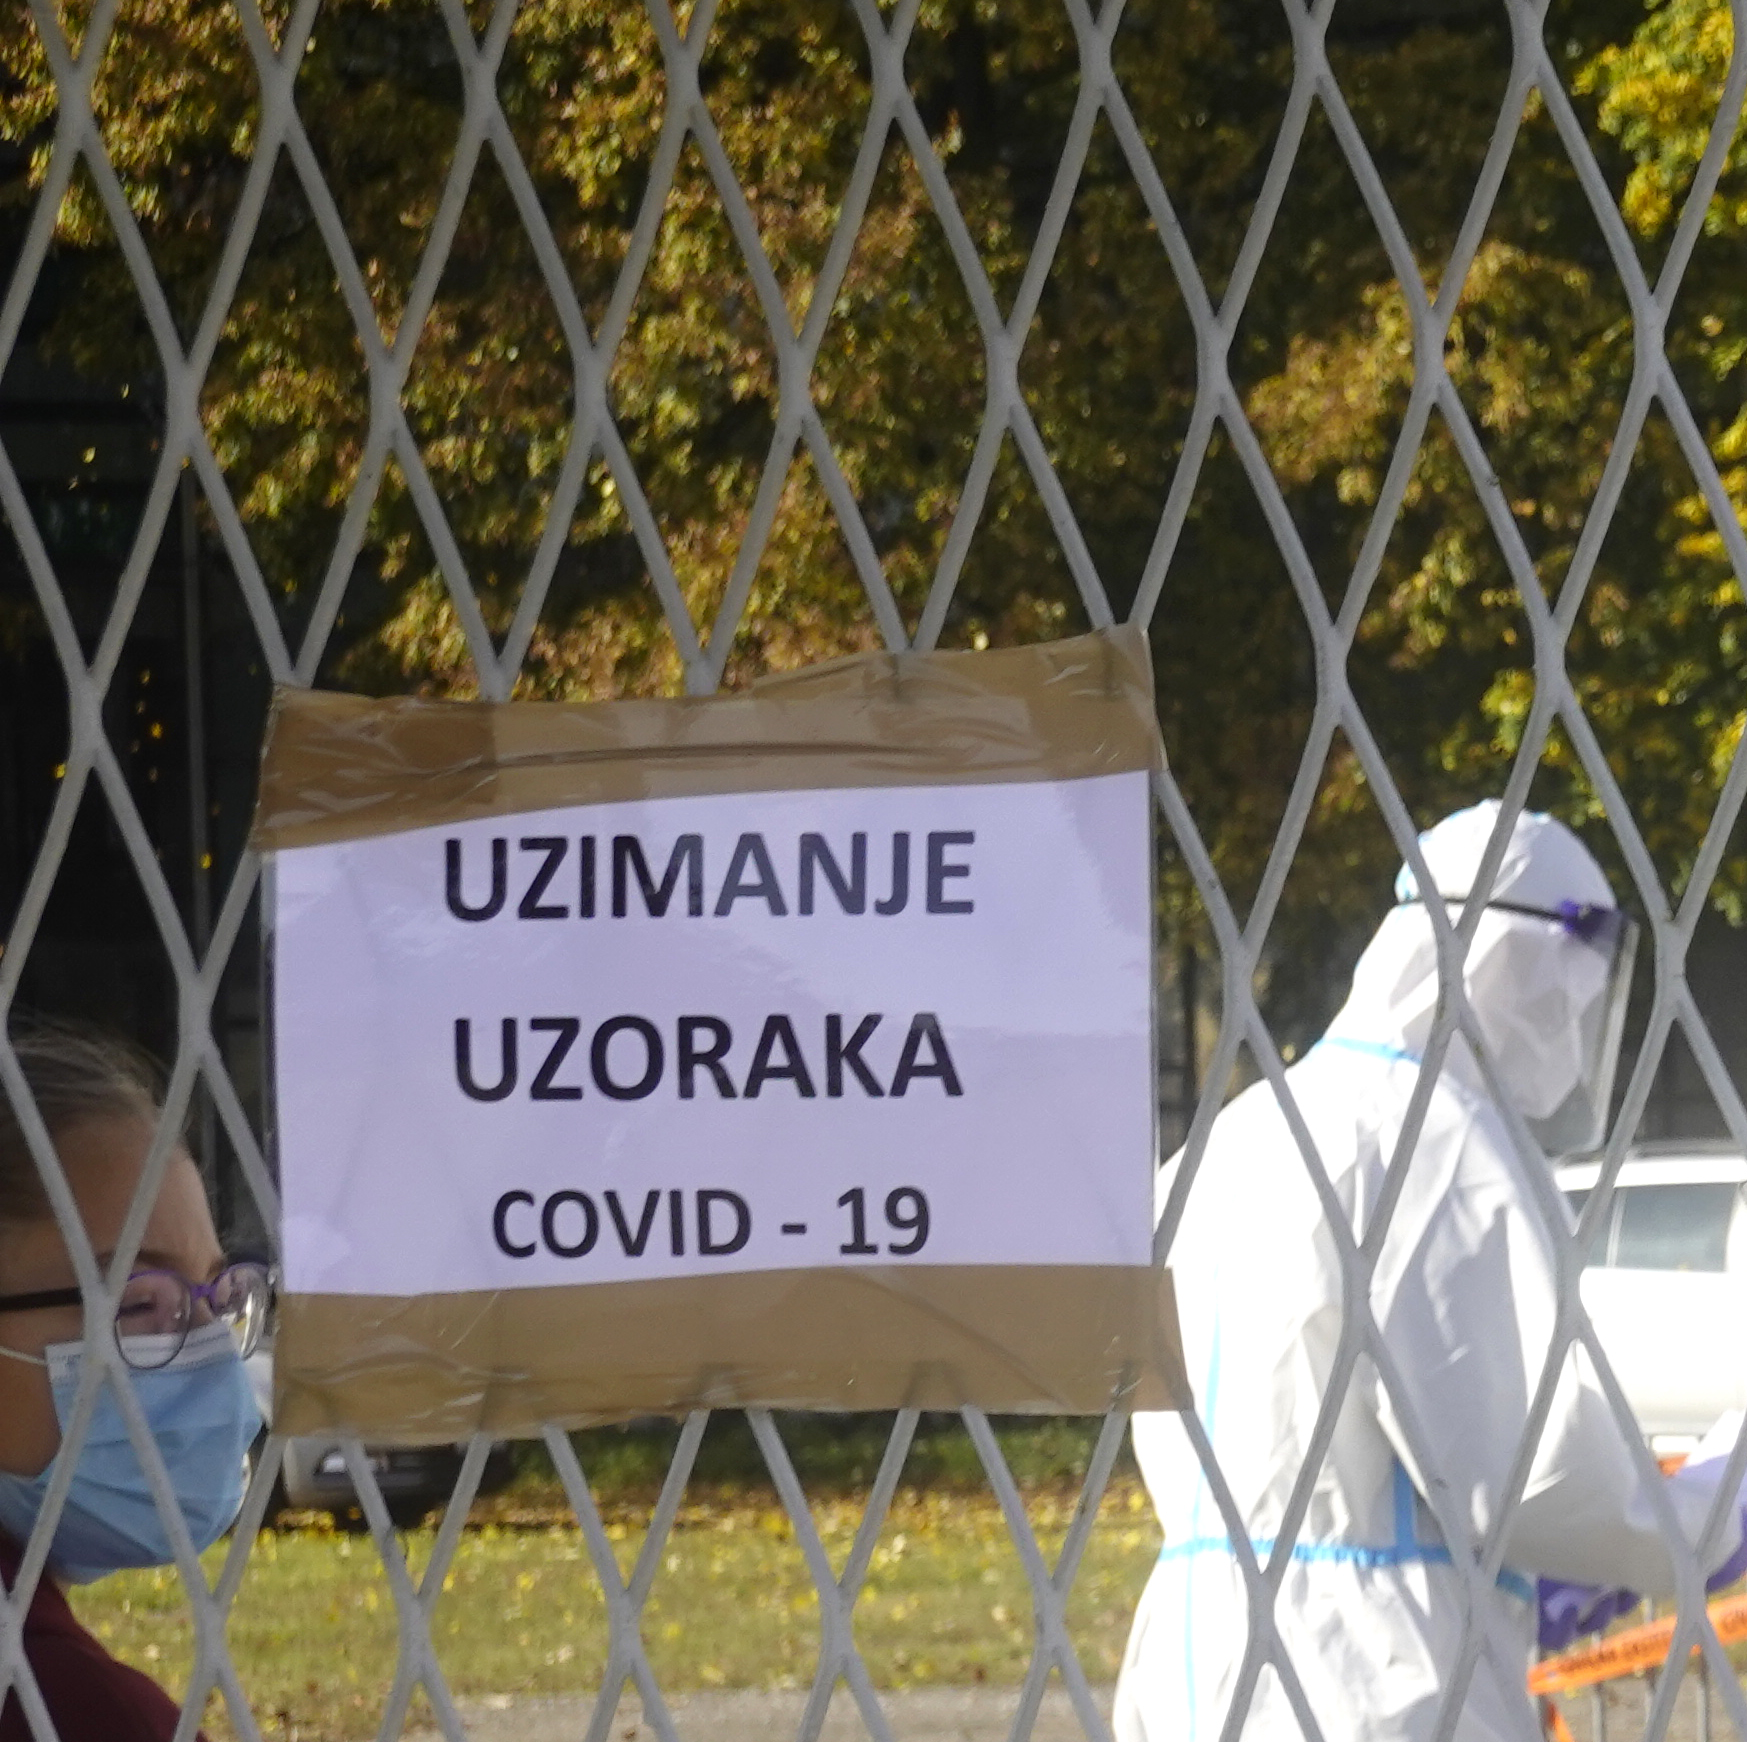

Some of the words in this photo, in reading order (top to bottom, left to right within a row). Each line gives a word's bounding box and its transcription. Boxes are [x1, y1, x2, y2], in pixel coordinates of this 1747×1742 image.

[443, 829, 976, 923] UZIMANJE
[453, 1012, 964, 1103] UZORAKA
[492, 1188, 752, 1259] COVID
[837, 1186, 930, 1256] 19
